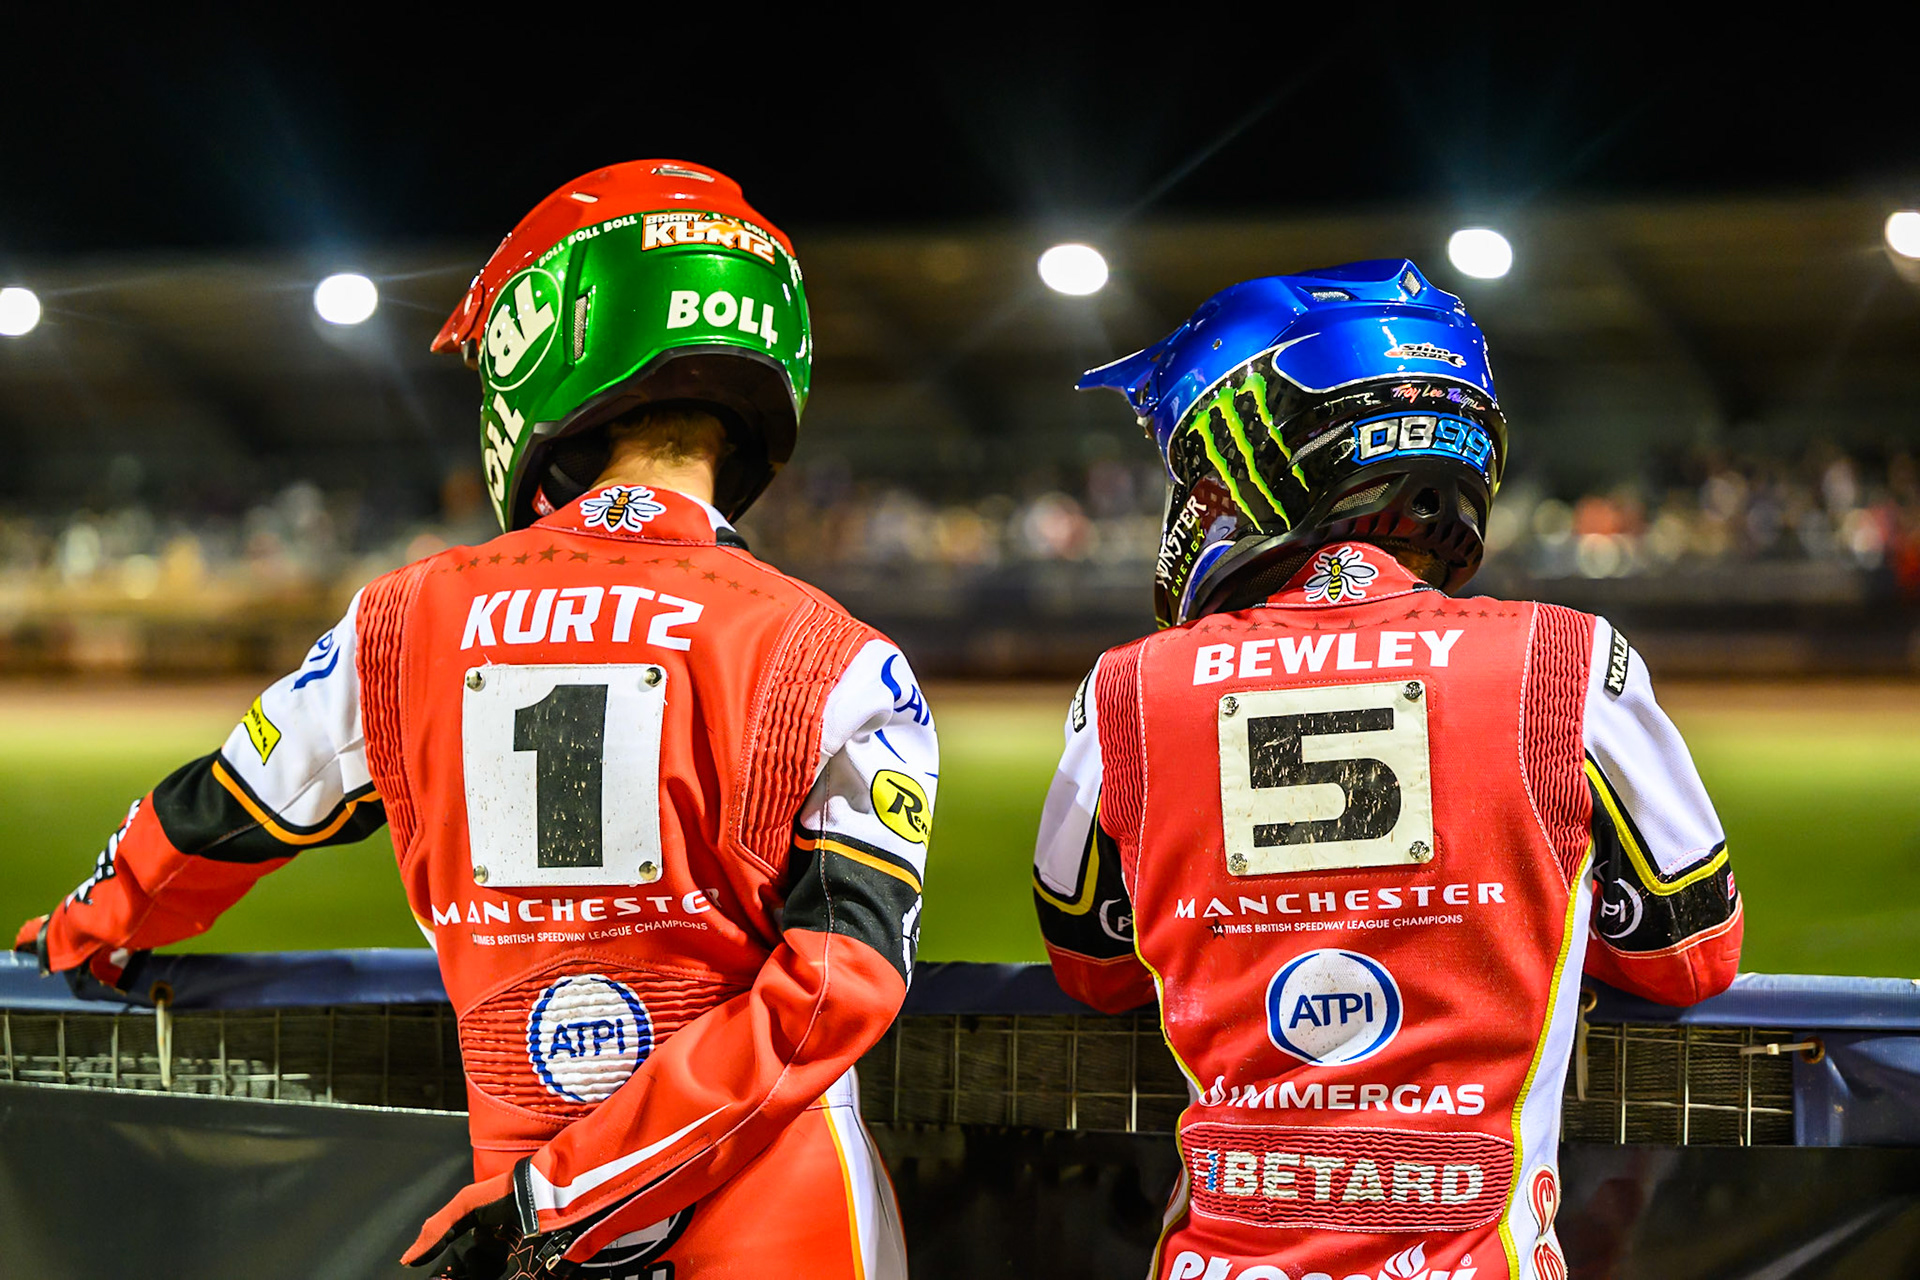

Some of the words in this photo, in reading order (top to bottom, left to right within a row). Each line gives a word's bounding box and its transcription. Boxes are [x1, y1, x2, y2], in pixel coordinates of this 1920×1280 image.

[645, 212, 704, 223] BRADY
[539, 242, 565, 267] BOLL
[567, 226, 600, 246] BOLL
[603, 215, 637, 233] BOLL
[644, 219, 775, 265] KURTZ
[1391, 384, 1421, 403] Troy
[1421, 383, 1446, 398] Lee
[1359, 416, 1491, 468] DB99
[1172, 528, 1206, 597] ENERGY
[460, 585, 704, 651] KURTZ
[1192, 629, 1465, 686] BEWLEY
[513, 684, 608, 868] 1
[1247, 707, 1402, 847] 5
[1174, 882, 1506, 918] MANCHESTER
[497, 932, 535, 945] BRITISH
[537, 931, 586, 943] SPEEDWAY
[588, 925, 632, 941] LEAGUE
[634, 919, 709, 934] CHAMPIONS
[1224, 924, 1253, 934] TIMES
[1255, 922, 1292, 933] BRITISH
[1294, 920, 1345, 932] SPEEDWAY
[1346, 918, 1390, 930] LEAGUE
[1392, 914, 1463, 928] CHAMPIONS
[1288, 992, 1374, 1029] ATPI
[548, 1017, 626, 1060] ATPI
[1226, 1080, 1486, 1116] IMMERGAS
[1222, 1152, 1485, 1206] BETARD
